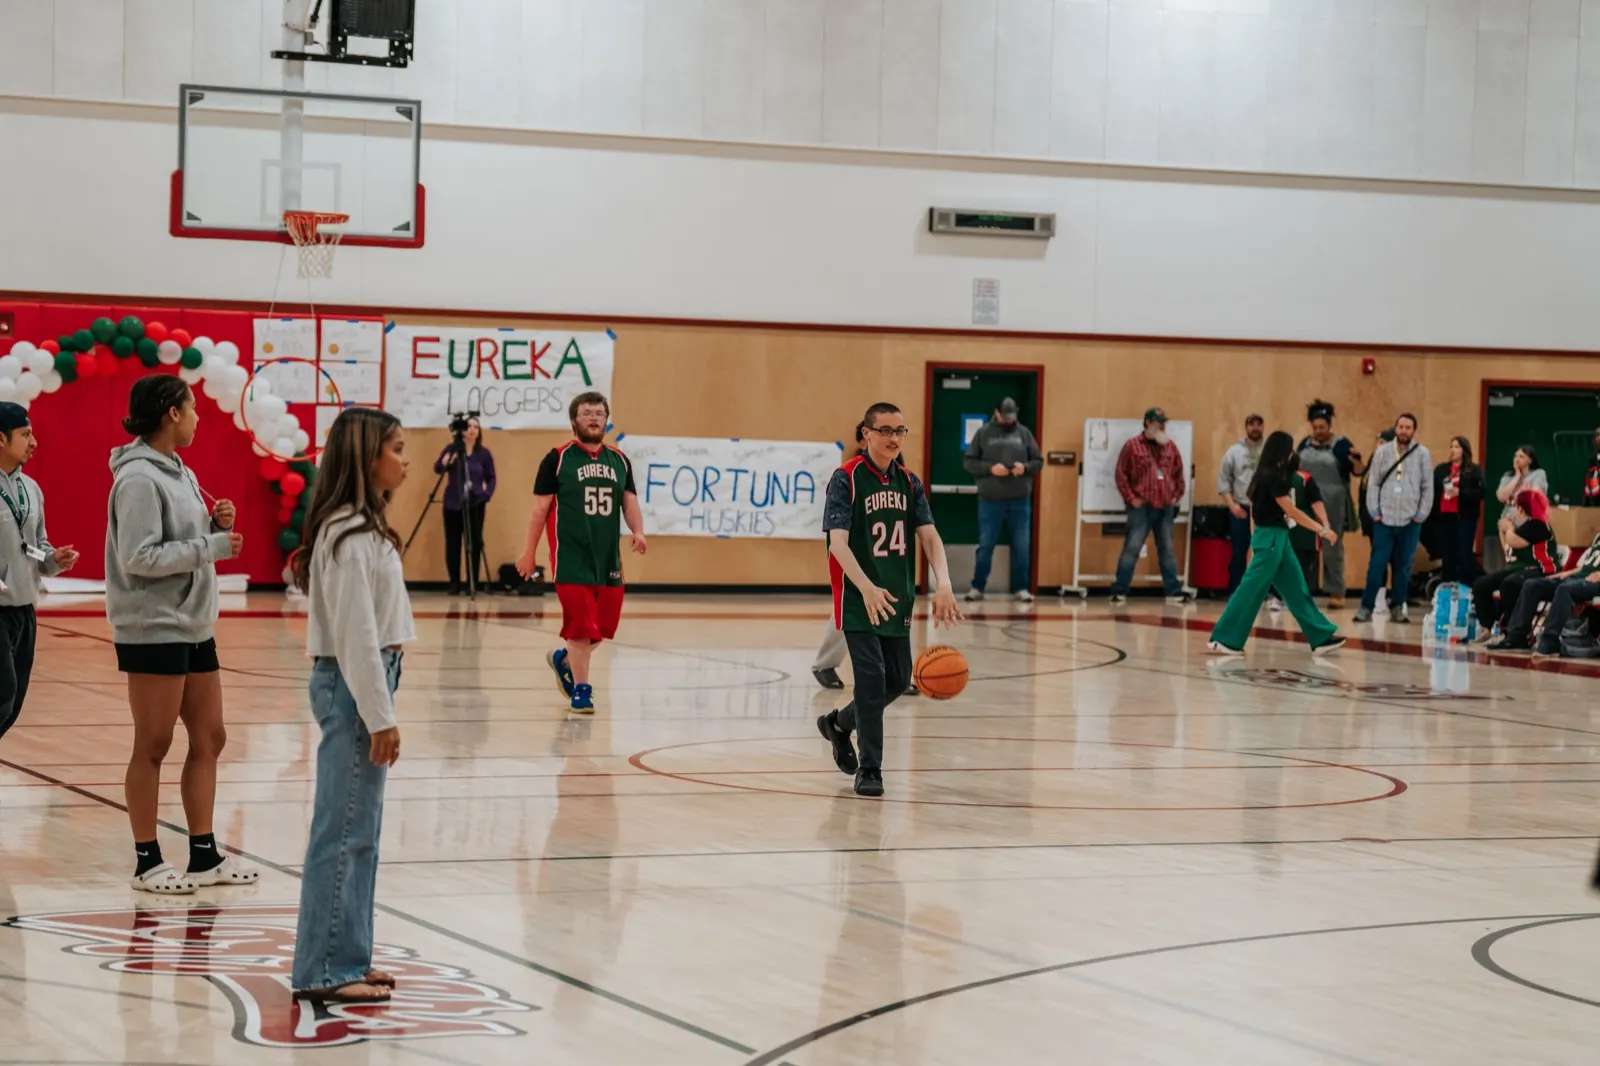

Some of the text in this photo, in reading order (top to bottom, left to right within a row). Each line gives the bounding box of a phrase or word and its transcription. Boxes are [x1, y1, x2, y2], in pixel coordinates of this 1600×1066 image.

[412, 336, 592, 386] EUREKA
[447, 382, 563, 417] LOGGERS
[577, 463, 618, 482] EUREKA
[645, 463, 816, 508] FORTUNA
[584, 486, 613, 516] 55
[689, 507, 776, 536] HUSKIES
[871, 520, 907, 558] 24
